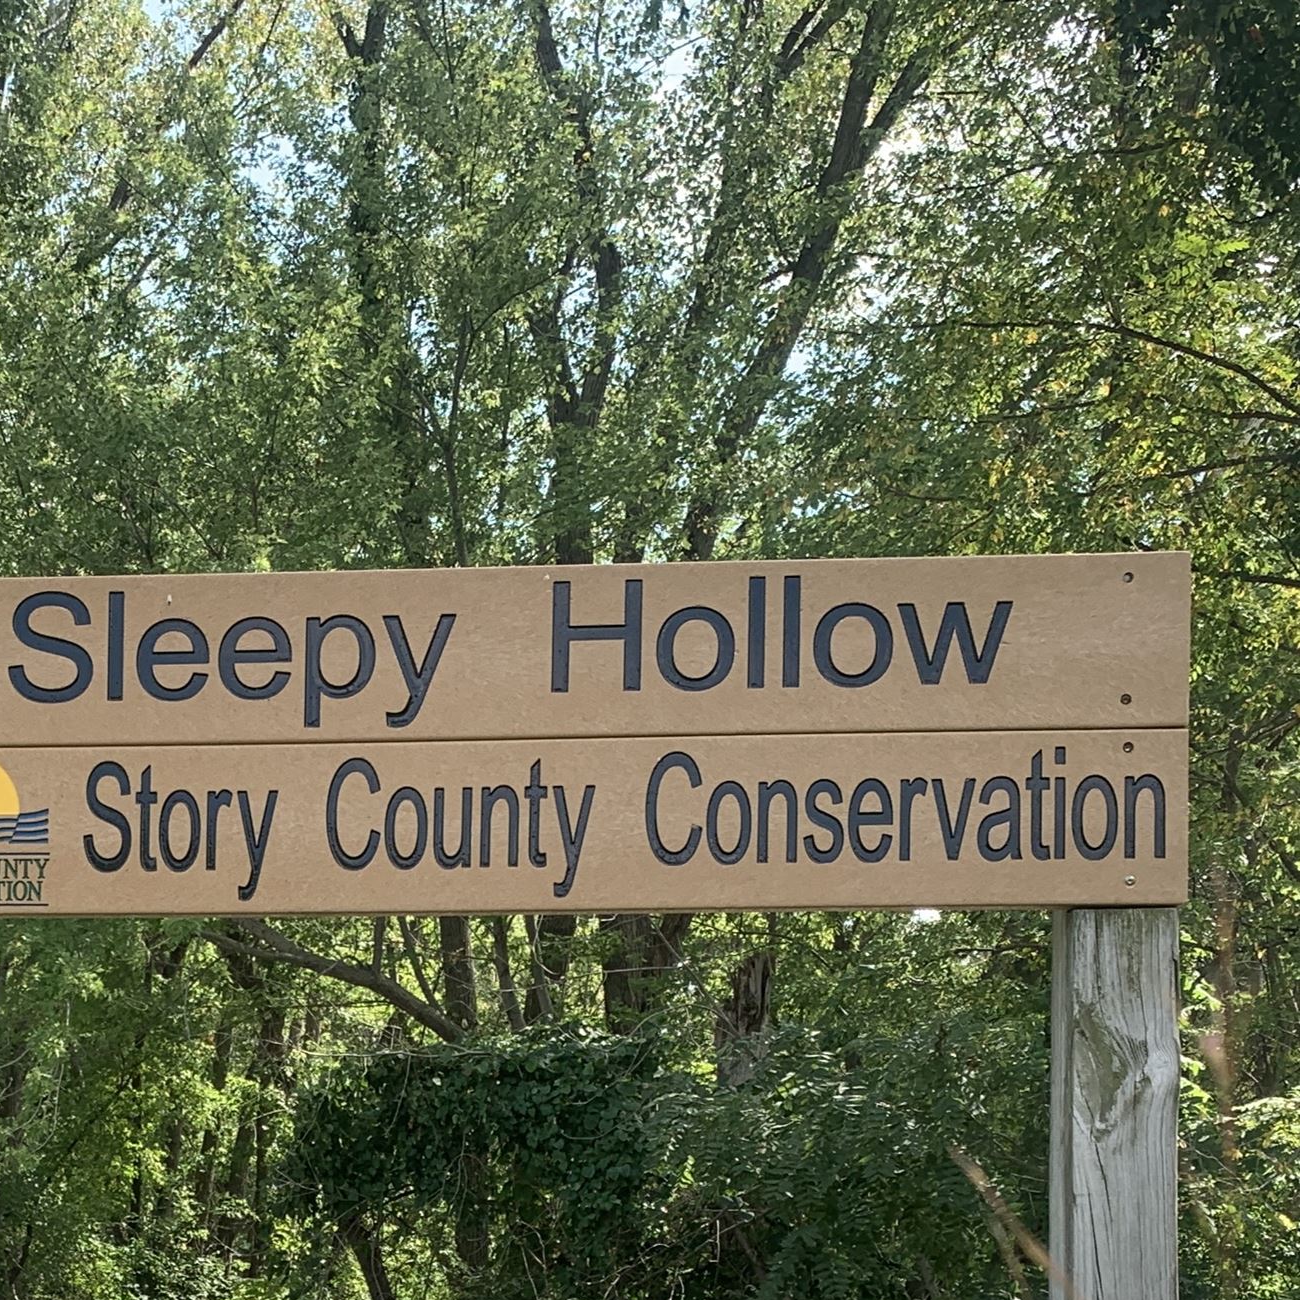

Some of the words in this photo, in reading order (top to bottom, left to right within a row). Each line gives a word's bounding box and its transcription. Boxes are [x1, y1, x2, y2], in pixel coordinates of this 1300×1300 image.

[8, 590, 457, 728] Sleepy
[550, 574, 1014, 693] Hollow
[82, 759, 279, 901] Story
[325, 756, 596, 897] County
[645, 746, 1167, 866] Conservation
